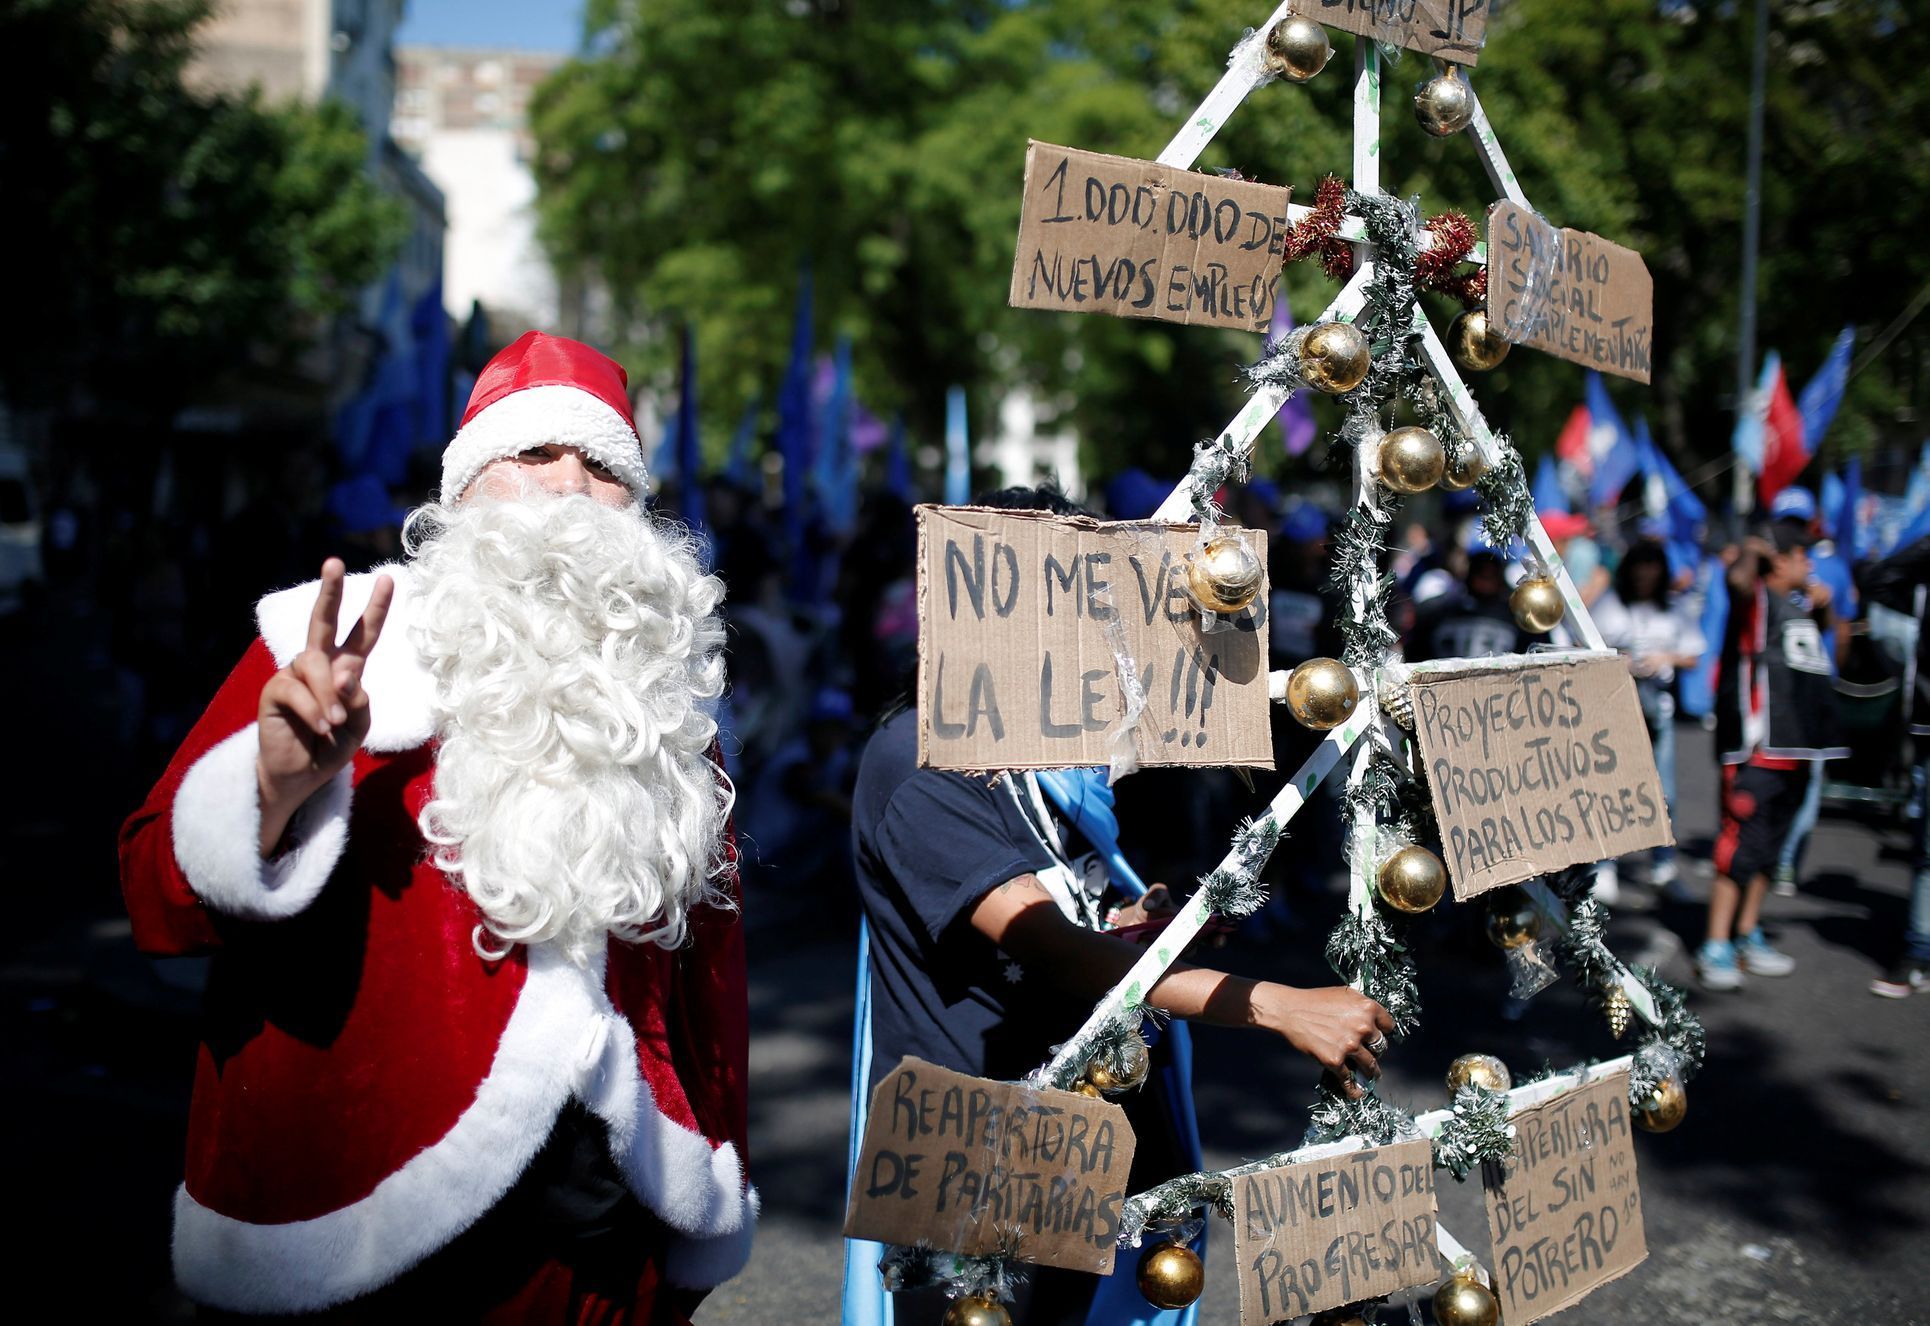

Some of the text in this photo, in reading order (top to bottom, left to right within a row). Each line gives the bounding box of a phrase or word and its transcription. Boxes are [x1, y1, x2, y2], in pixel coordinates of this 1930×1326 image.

[1239, 211, 1288, 255] DE
[1028, 248, 1157, 309] NUEVOS
[1167, 262, 1282, 329] EMPLEOS
[945, 533, 1020, 622] NO
[1044, 551, 1113, 621] ME
[933, 651, 1004, 742] LA
[1419, 674, 1583, 759] PROYECTOS
[1433, 729, 1617, 815] PRODUCTIVOS
[1450, 815, 1525, 884] PARA
[1520, 803, 1575, 850] LOS
[892, 1071, 1115, 1174] REAPERTURA
[867, 1150, 927, 1199] DE
[1246, 1151, 1437, 1242] AUMENTO DEL
[1495, 1155, 1597, 1246] DEL SIN
[1252, 1214, 1441, 1317] PROGRESAR
[1502, 1206, 1618, 1311] POTRERO
